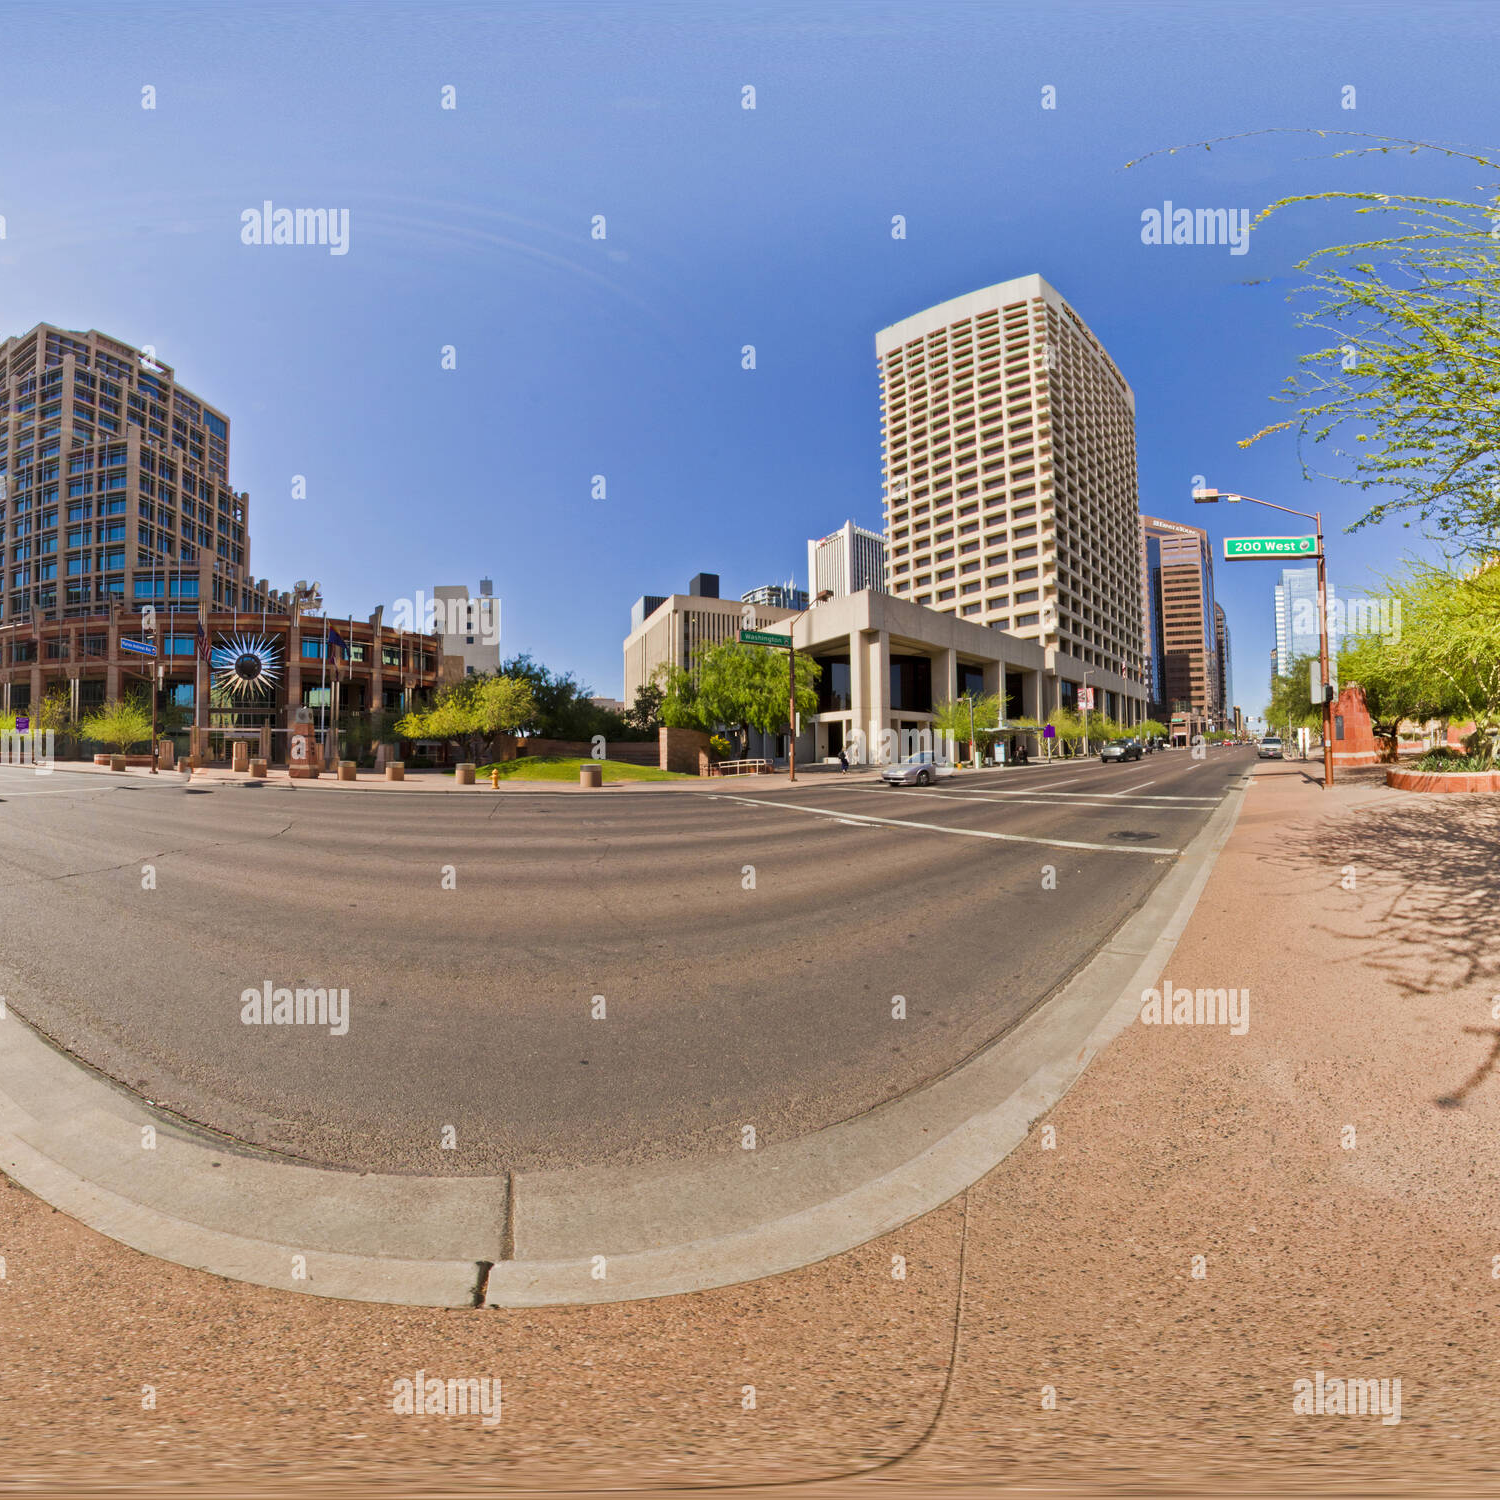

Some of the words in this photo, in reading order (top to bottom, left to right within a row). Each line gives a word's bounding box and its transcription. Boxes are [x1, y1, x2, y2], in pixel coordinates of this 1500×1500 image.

[1235, 542, 1261, 552] 200
[1265, 541, 1296, 551] West
[745, 633, 782, 643] Washington
